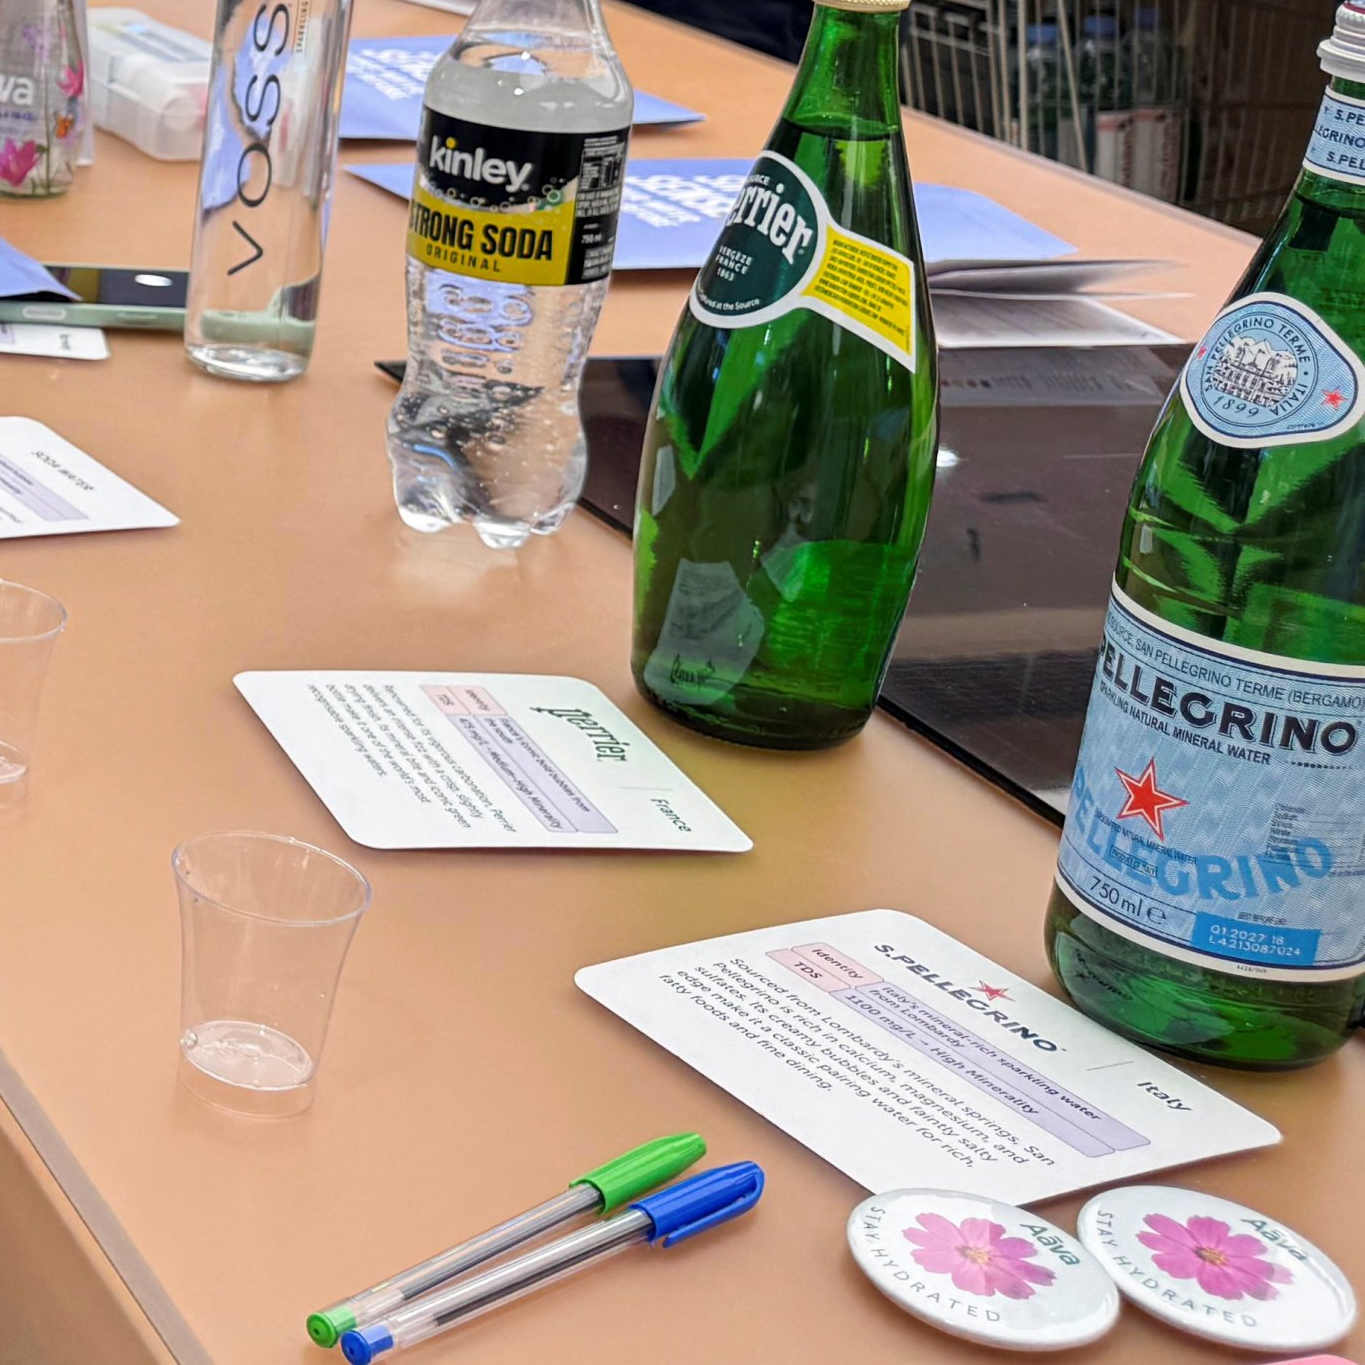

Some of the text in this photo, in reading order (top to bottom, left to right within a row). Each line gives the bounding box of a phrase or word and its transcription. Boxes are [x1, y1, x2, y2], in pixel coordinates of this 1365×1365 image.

[227, 1, 290, 276] VOSS
[429, 135, 532, 193] kinley
[426, 243, 501, 273] ORIGINAL
[480, 223, 553, 261] SODA
[715, 254, 749, 275] FRANCE
[717, 267, 735, 282] 1863
[723, 303, 734, 311] the
[735, 298, 760, 311] Source
[1204, 317, 1311, 416] SAN PELLEGRINO TERME ITALIA
[1213, 395, 1260, 418] 1899
[1135, 638, 1155, 659] SAN
[1155, 649, 1233, 688] PELLEGRINO
[1236, 678, 1284, 700] TERME
[531, 707, 630, 761] perrier
[1130, 706, 1170, 735] NATURAL
[1172, 726, 1223, 753] MINERAL
[1227, 745, 1271, 765] WATER
[528, 797, 562, 828] Minerality
[651, 799, 691, 832] France
[1091, 875, 1143, 918] 750 ml
[659, 975, 691, 993] fatty
[691, 996, 729, 1021] foods
[729, 1023, 760, 1039] and
[757, 1040, 785, 1057] fine
[869, 990, 965, 1047] from Lombardy
[875, 945, 1065, 1051] S.PELLEGRINO
[678, 971, 711, 991] edge
[711, 994, 749, 1017] make
[773, 1034, 819, 1063] classic
[816, 1065, 871, 1097] pairing
[872, 1098, 917, 1125] water
[916, 1128, 942, 1142] for
[713, 963, 779, 1005] Pellegrino
[793, 1015, 821, 1032] rich
[822, 1033, 838, 1042] in
[994, 1145, 1029, 1163] and
[730, 959, 788, 993] Sourced
[786, 995, 821, 1016] from
[821, 1017, 904, 1068] Lombardy's
[904, 1070, 964, 1106] mineral
[1024, 1146, 1054, 1165] San
[794, 962, 1038, 1113] TDS 1100 mg/L High Minerality
[812, 949, 1101, 1119] Identity Italy's mineral-rich sparkling water
[749, 1002, 768, 1013] Its
[769, 1015, 821, 1046] creamy
[821, 1048, 878, 1085] bubbles
[879, 1087, 912, 1105] and
[910, 1107, 959, 1136] faintly
[958, 1139, 998, 1161] salty
[1138, 1082, 1191, 1110] Italy
[862, 1206, 1002, 1324] STAY HYDRATED
[1096, 1210, 1258, 1328] STAY HYDRATED
